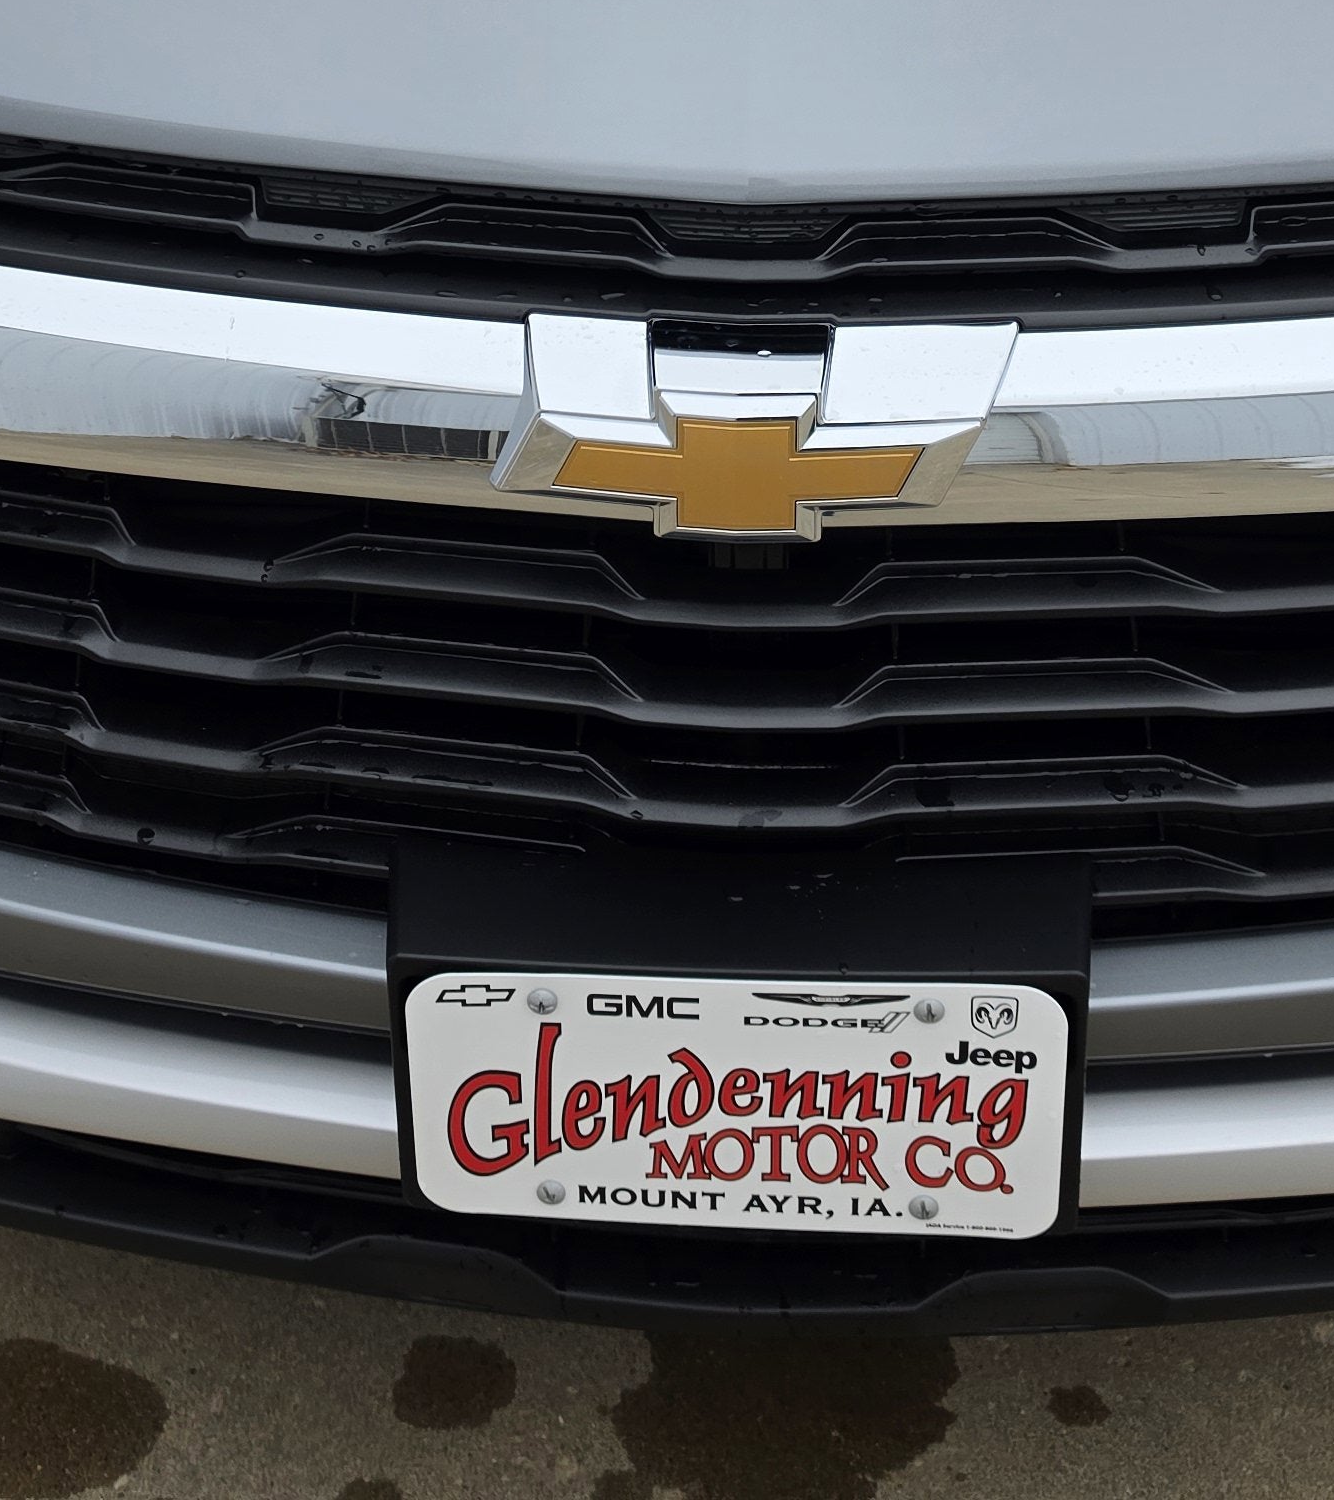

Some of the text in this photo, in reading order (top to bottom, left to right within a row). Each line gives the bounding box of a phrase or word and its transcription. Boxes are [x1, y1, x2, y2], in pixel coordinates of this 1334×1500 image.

[586, 993, 700, 1020] GMC
[744, 1016, 885, 1029] DODGE
[945, 1041, 1037, 1074] Jeep
[447, 1022, 1029, 1177] Glendenning
[645, 1123, 889, 1190] MOTOR
[578, 1185, 903, 1219] MOUNT AYR, IA.
